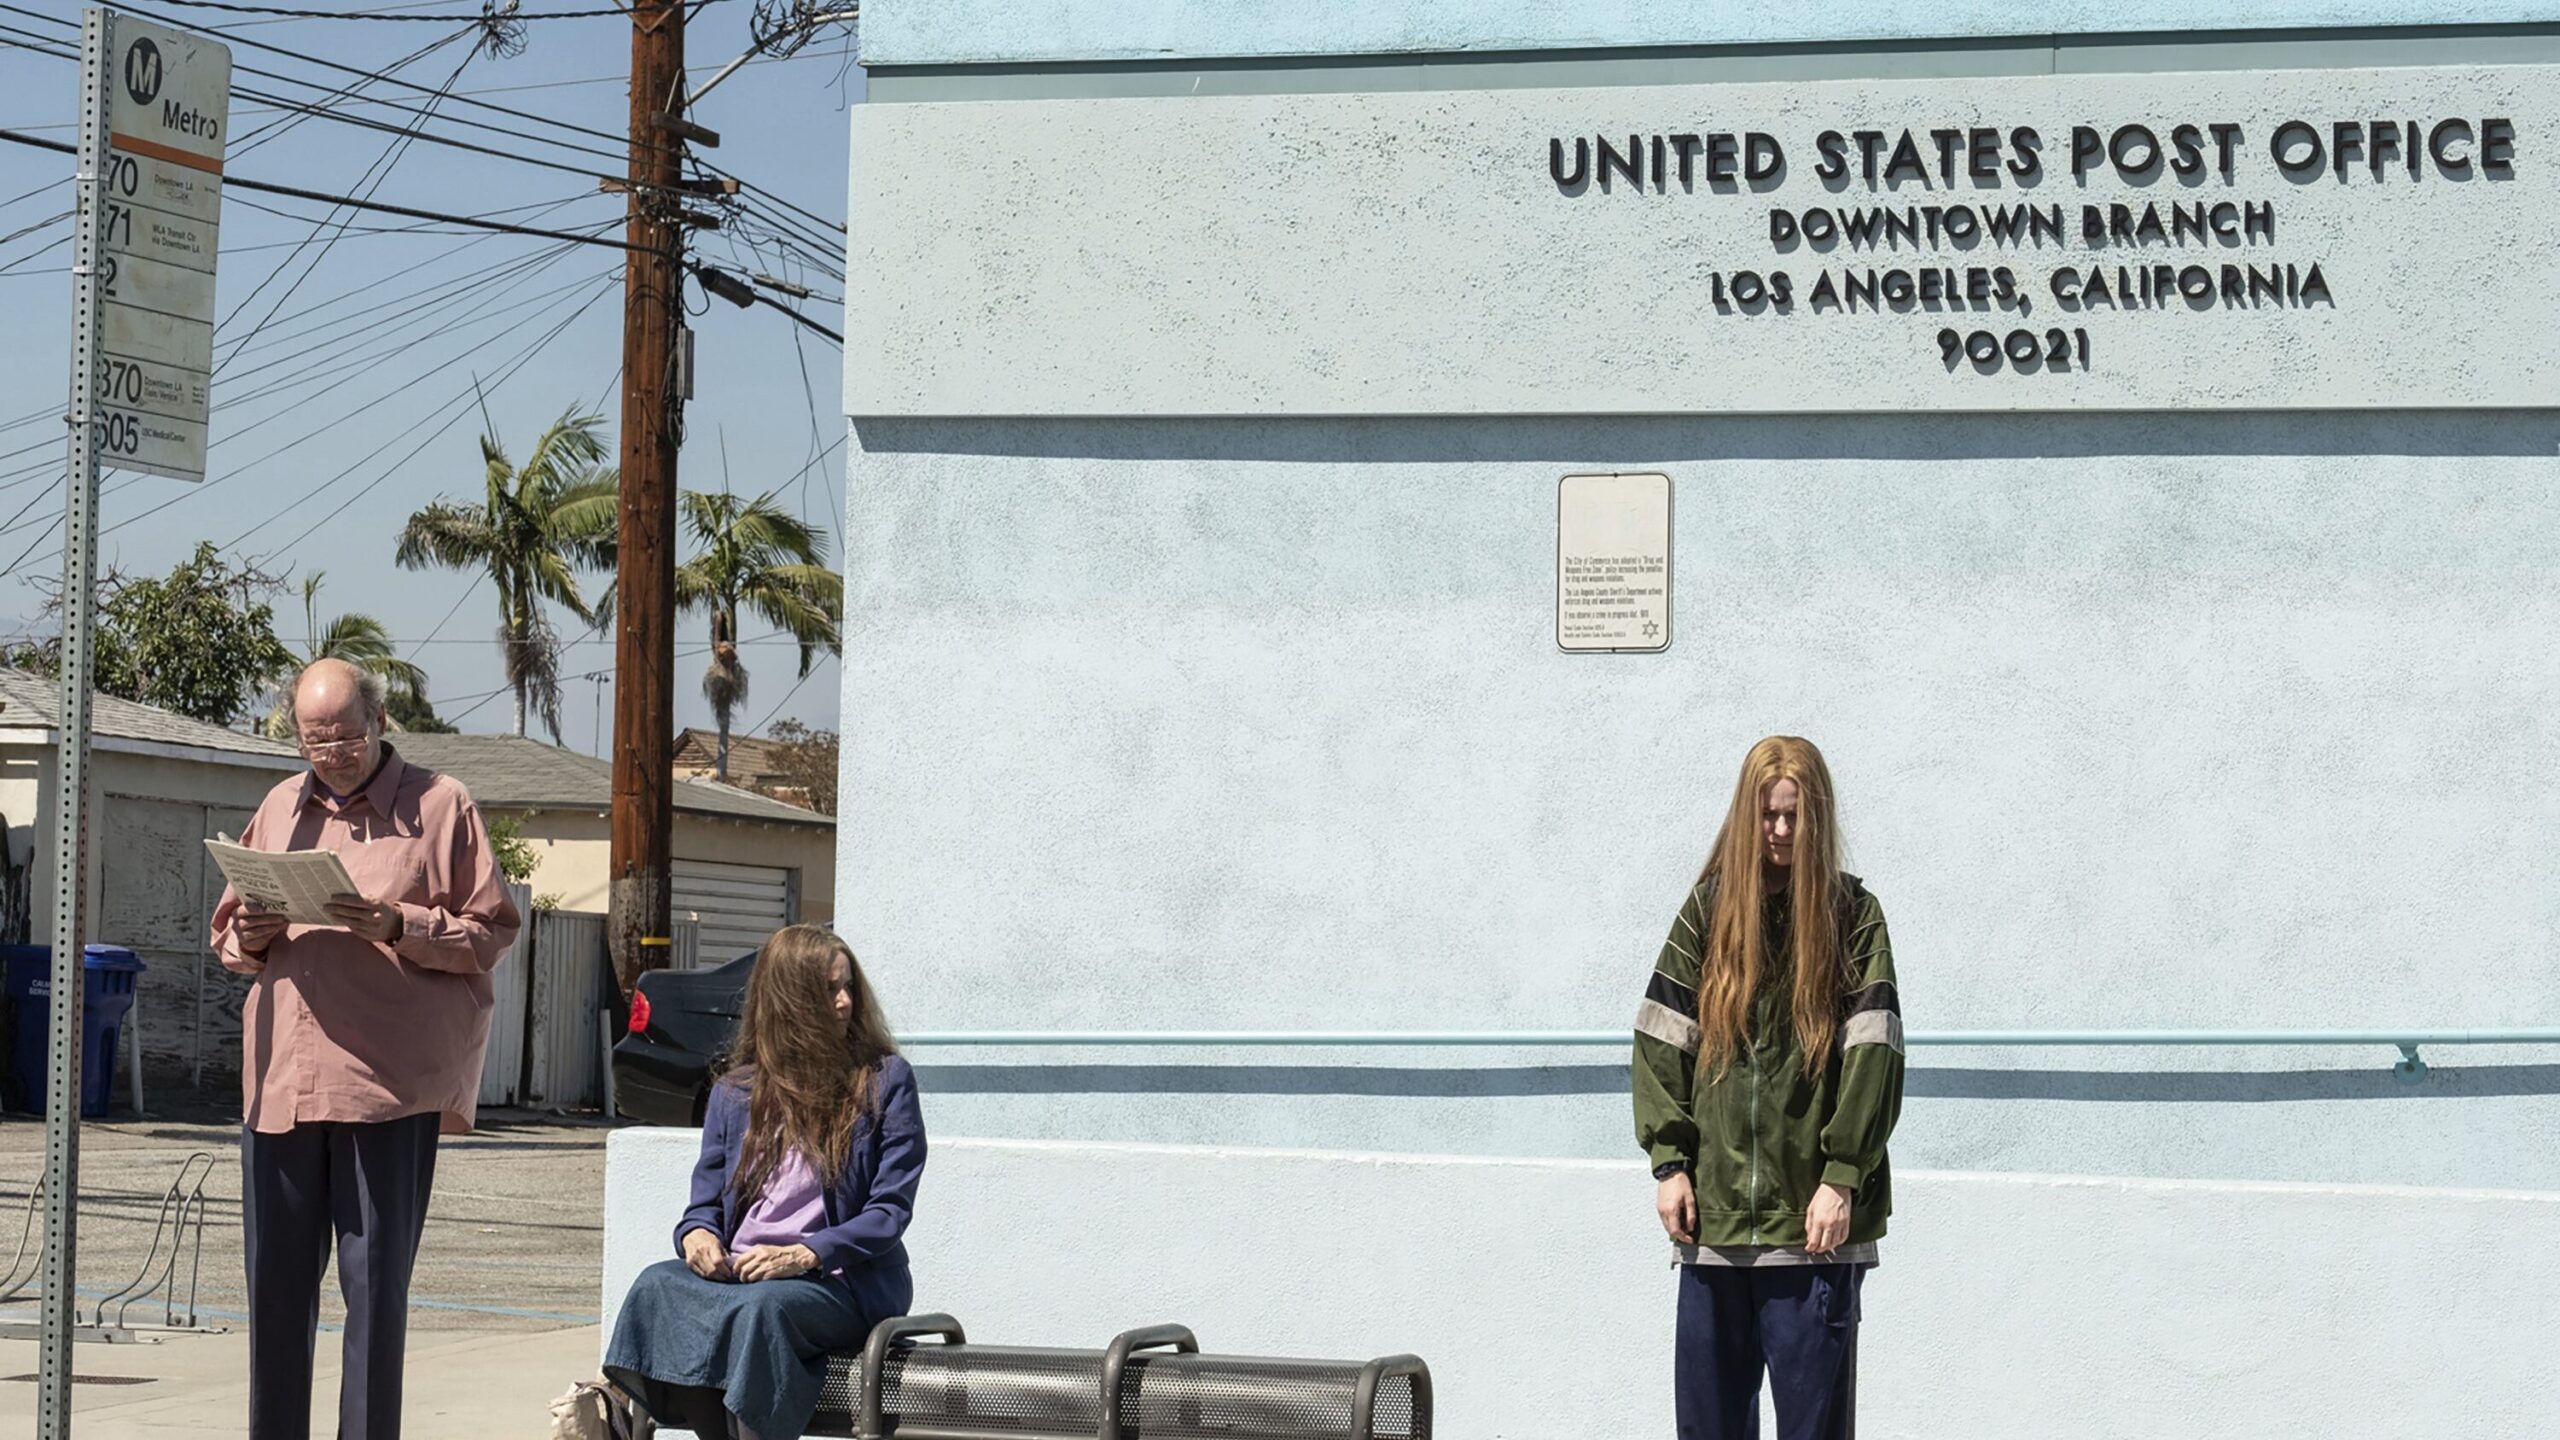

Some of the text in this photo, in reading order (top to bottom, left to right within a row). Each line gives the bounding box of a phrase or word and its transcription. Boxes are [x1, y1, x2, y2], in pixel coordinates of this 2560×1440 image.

[162, 99, 218, 140] Metro
[1550, 118, 2512, 187] UNITED STATES POST OFFICE
[110, 154, 138, 197] 70
[186, 181, 194, 191] LA
[107, 204, 130, 246] 71
[1770, 200, 2273, 244] DOWNTOWN BRANCH
[161, 236, 191, 252] Downtown
[192, 244, 200, 254] LA
[1712, 262, 2331, 308] LOS ANGELES, CALIFORNIA
[1937, 328, 2087, 365] 90021
[174, 381, 182, 392] LA
